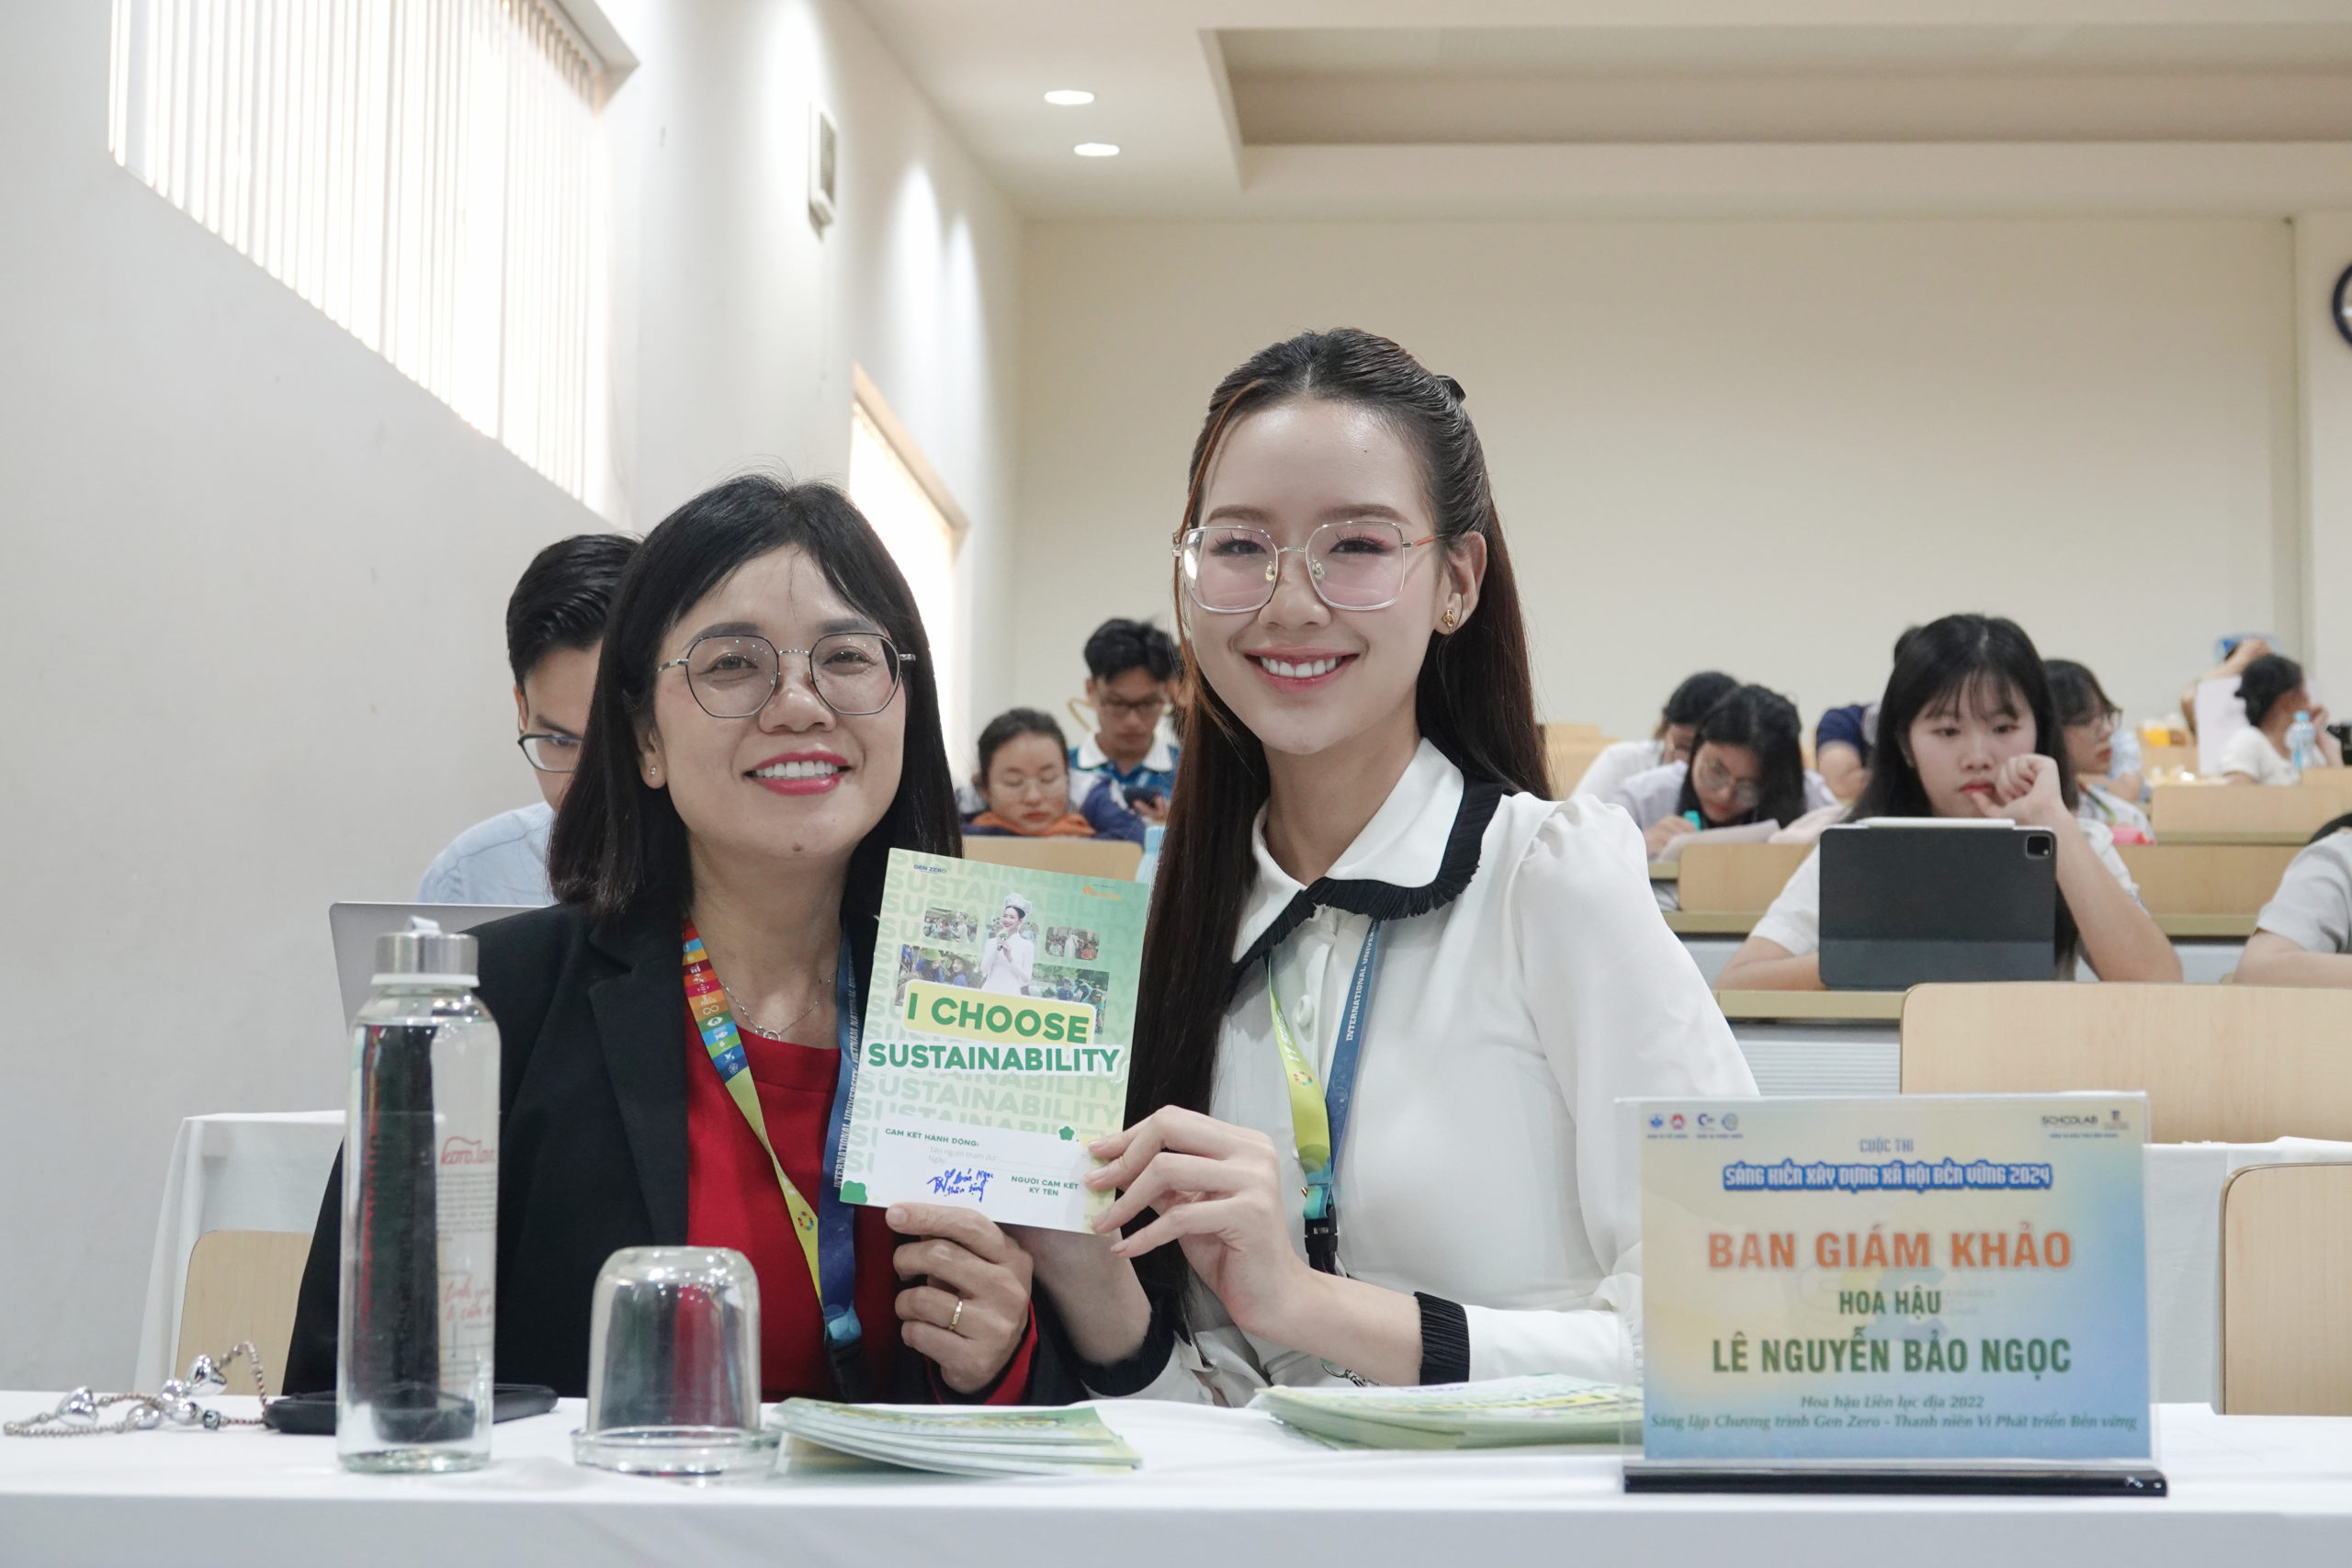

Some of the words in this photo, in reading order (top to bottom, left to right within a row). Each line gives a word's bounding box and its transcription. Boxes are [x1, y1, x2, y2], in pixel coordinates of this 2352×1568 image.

[907, 992, 919, 1020] I
[931, 997, 1090, 1044] CHOOSE
[1345, 964, 1367, 1042] INTERNATIONAL
[867, 1042, 1120, 1073] SUSTAINABILITY
[1860, 1137, 1891, 1156] CUỘC
[1896, 1139, 1914, 1153] THI
[1724, 1162, 1766, 1188] SÁNG
[1767, 1158, 1804, 1188] KIẾN
[1805, 1162, 1837, 1188] XÂY
[1838, 1165, 1880, 1192] DỰNG
[1883, 1161, 1903, 1188] XÃ
[1904, 1162, 1930, 1192] HỘI
[1965, 1160, 2007, 1187] VỮNG
[2008, 1164, 2052, 1187] 2024
[1707, 1232, 1796, 1269] BAN
[1815, 1224, 1931, 1269] GIÁM
[1951, 1221, 2073, 1269] KHẢO
[1838, 1291, 1886, 1315] HOA
[1894, 1284, 1942, 1320] HẬU
[1713, 1331, 1749, 1373] LÊ
[1760, 1325, 1891, 1373] NGUYỄN
[1903, 1328, 1969, 1373] BẢO
[1980, 1337, 2072, 1381] NGỌC
[1800, 1394, 1830, 1408] Hoa
[1833, 1394, 1861, 1412] hậu
[1864, 1394, 1894, 1408] Liên
[1897, 1394, 1918, 1412] lục
[1922, 1394, 1946, 1412] địa
[1950, 1395, 1985, 1409] 2022
[1650, 1414, 1685, 1431] Sáng
[1713, 1414, 1771, 1432] Chương
[1814, 1415, 1843, 1428] Gen
[1846, 1415, 1881, 1428] Zero
[1894, 1414, 1939, 1428] Thanh
[1942, 1416, 1975, 1428] niên
